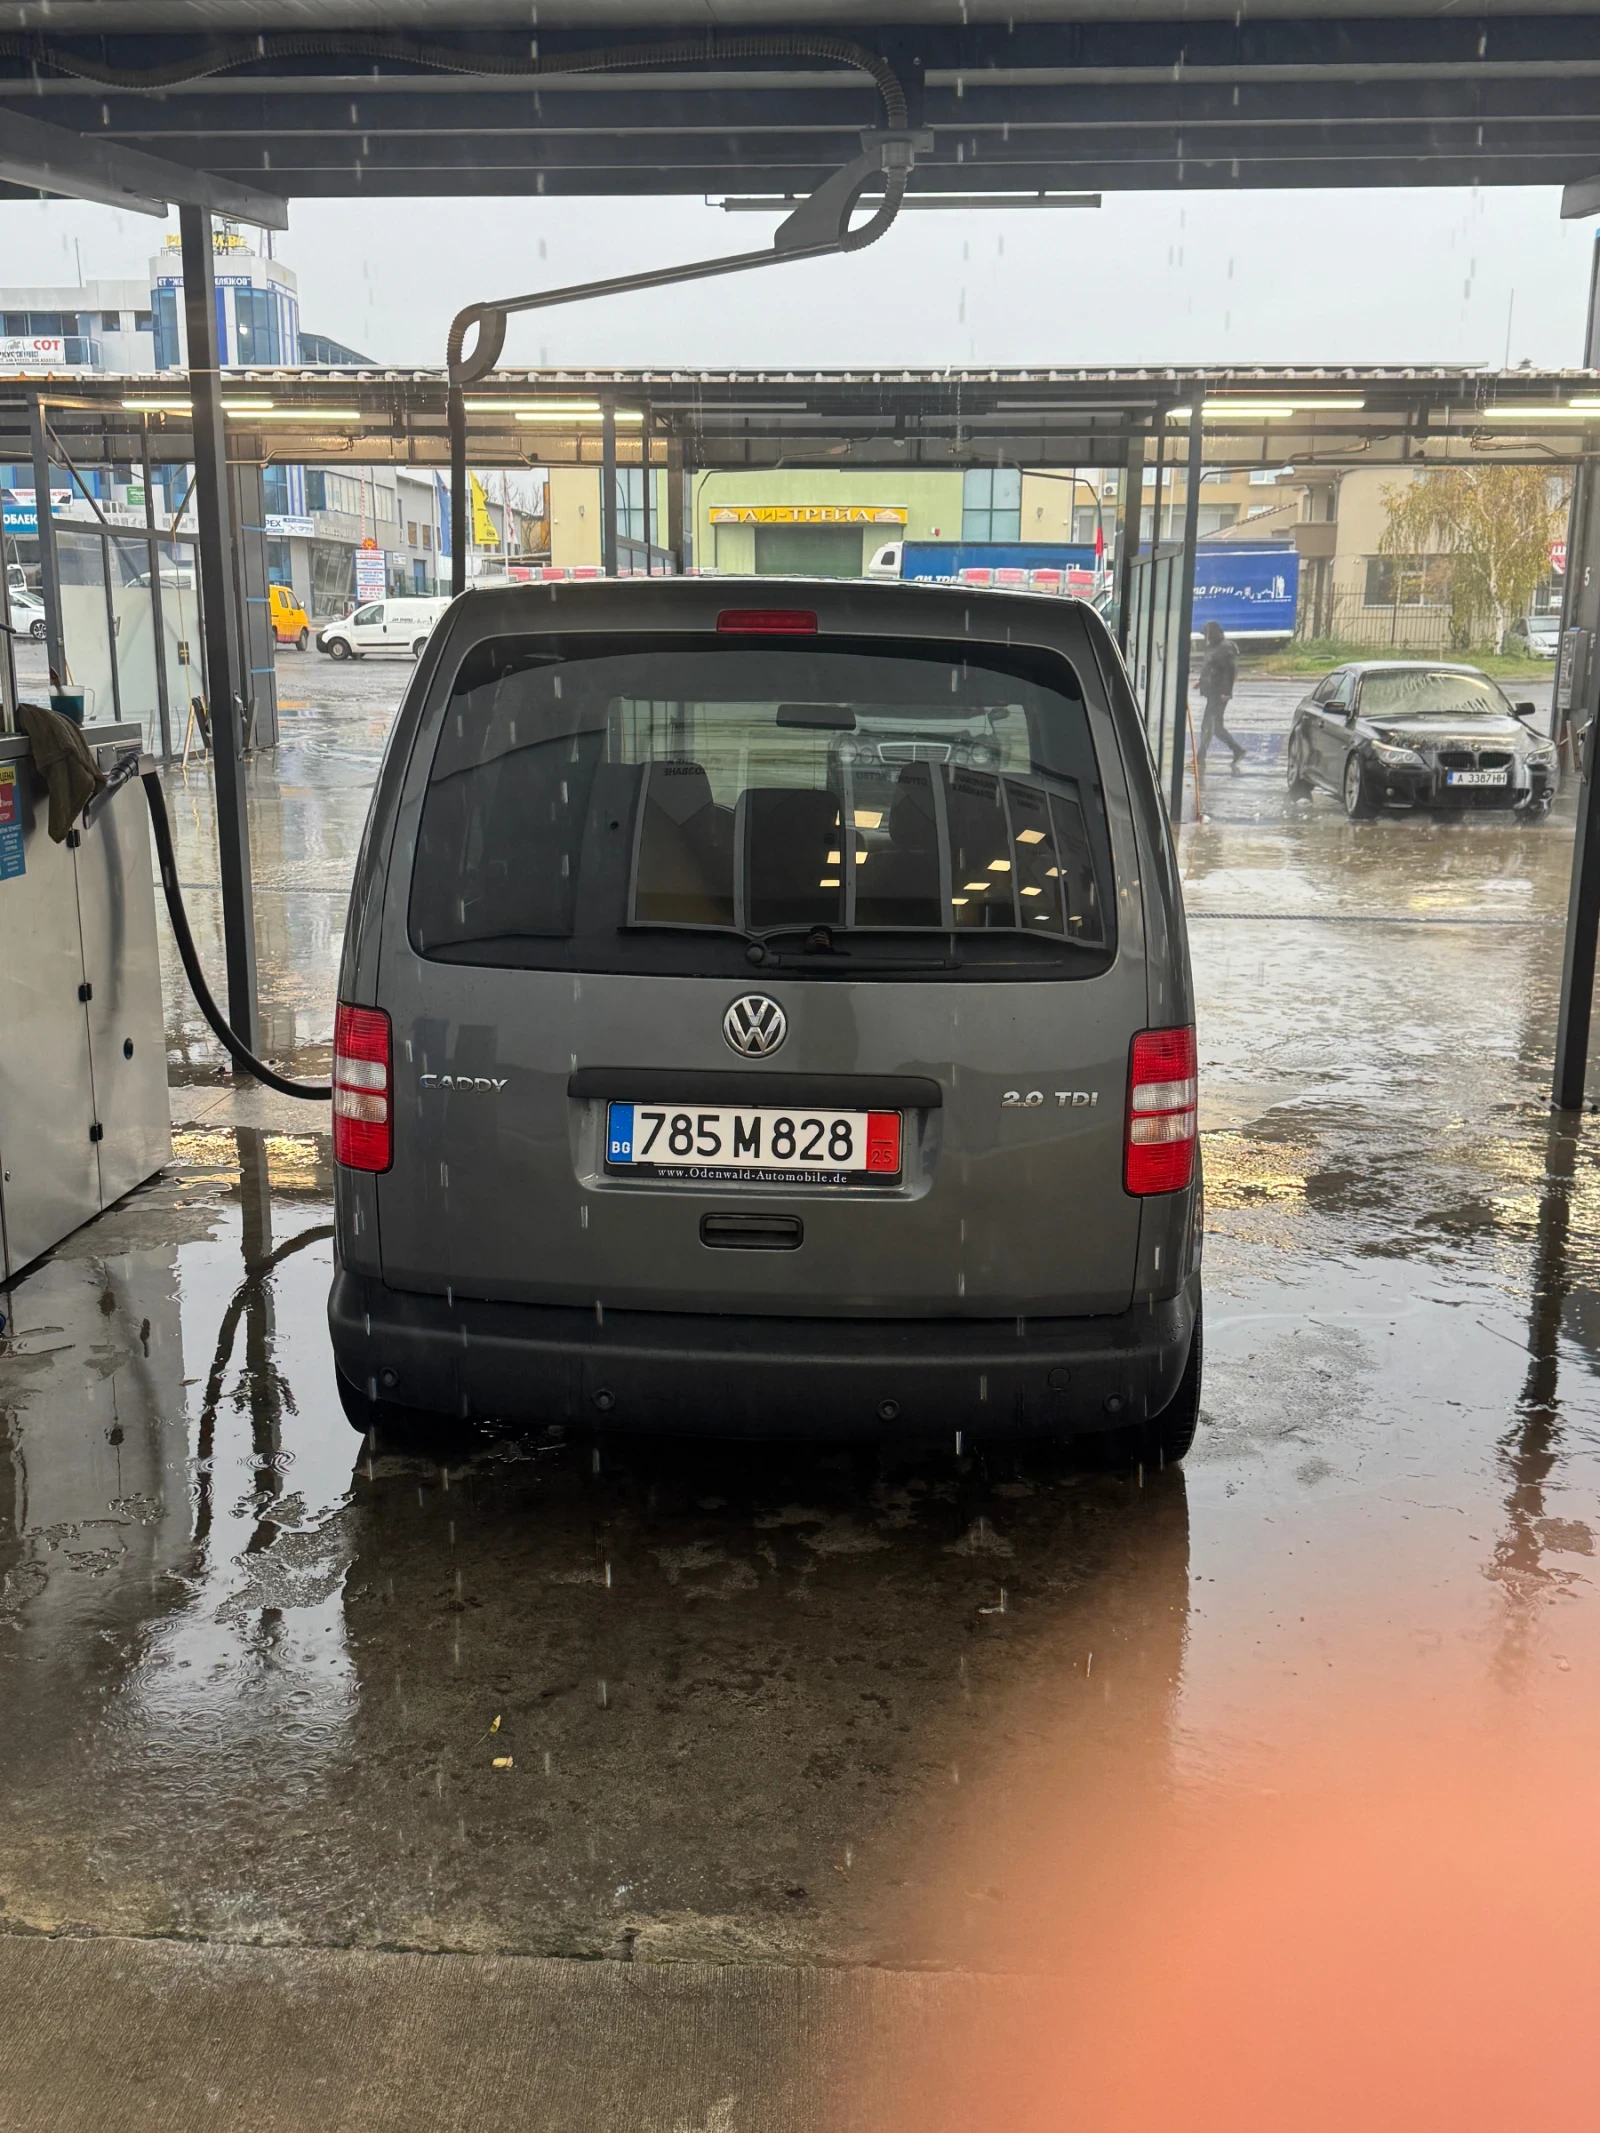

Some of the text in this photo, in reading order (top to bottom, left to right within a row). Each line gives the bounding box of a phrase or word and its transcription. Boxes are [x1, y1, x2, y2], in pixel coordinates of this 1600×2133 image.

[33, 339, 61, 351] СОТ
[1584, 566, 1590, 586] 5
[419, 1073, 509, 1094] CADDY
[1001, 1090, 1099, 1107] 2.0 TDI
[640, 1112, 854, 1162] 785 M 828
[611, 1141, 631, 1154] BG
[871, 1149, 893, 1165] 25
[657, 1166, 847, 1183] www.Odenwald-Automobile.de
